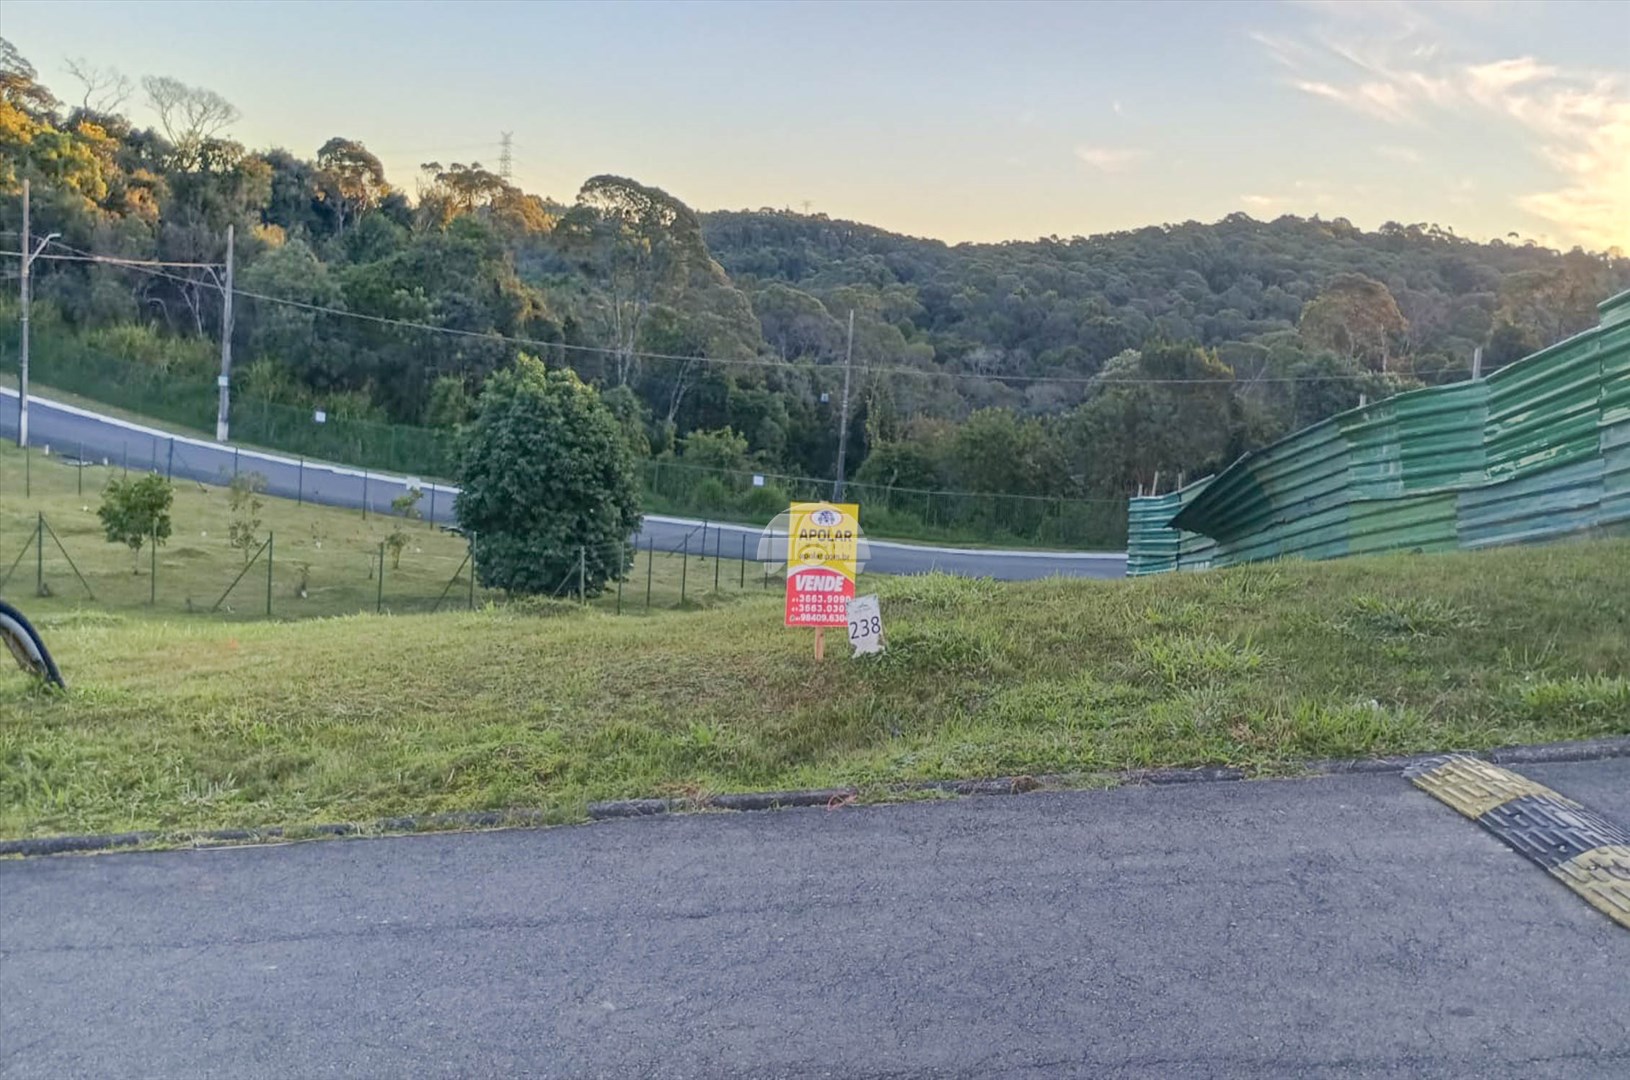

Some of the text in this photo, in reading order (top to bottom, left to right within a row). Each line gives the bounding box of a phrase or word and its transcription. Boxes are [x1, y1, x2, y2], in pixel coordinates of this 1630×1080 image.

[799, 528, 852, 542] APOLAR
[795, 574, 845, 592] VENDE
[850, 616, 881, 639] 238
